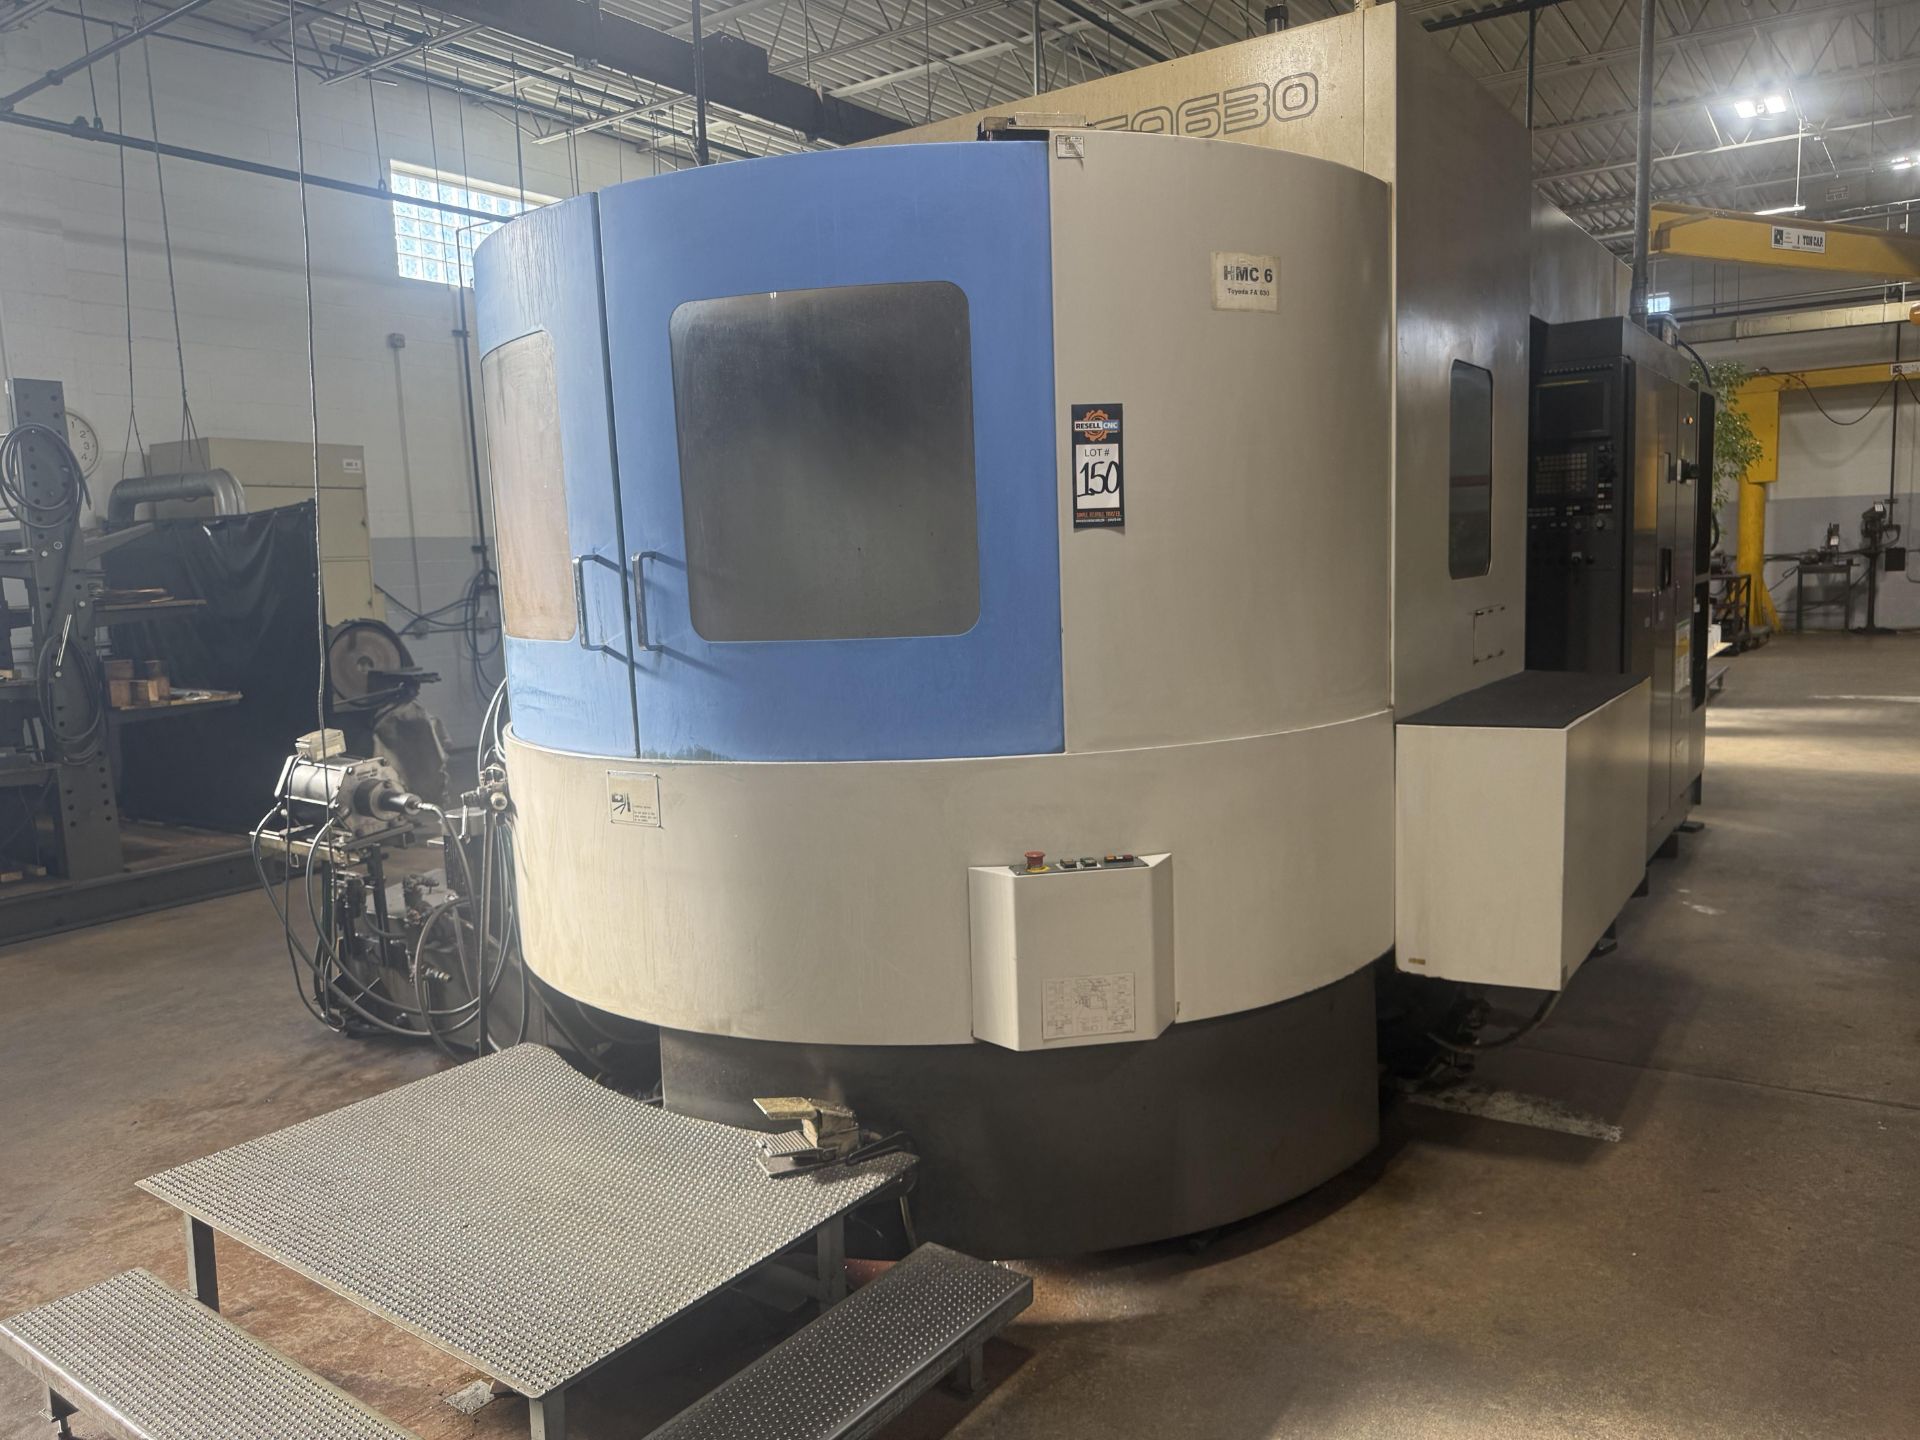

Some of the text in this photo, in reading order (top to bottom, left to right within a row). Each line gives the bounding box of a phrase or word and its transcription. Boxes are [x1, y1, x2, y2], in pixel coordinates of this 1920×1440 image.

[1223, 265, 1273, 283] HMC 6
[1075, 421, 1119, 430] RESELL CNC
[1084, 448, 1111, 457] LOT #
[1077, 460, 1121, 498] 150
